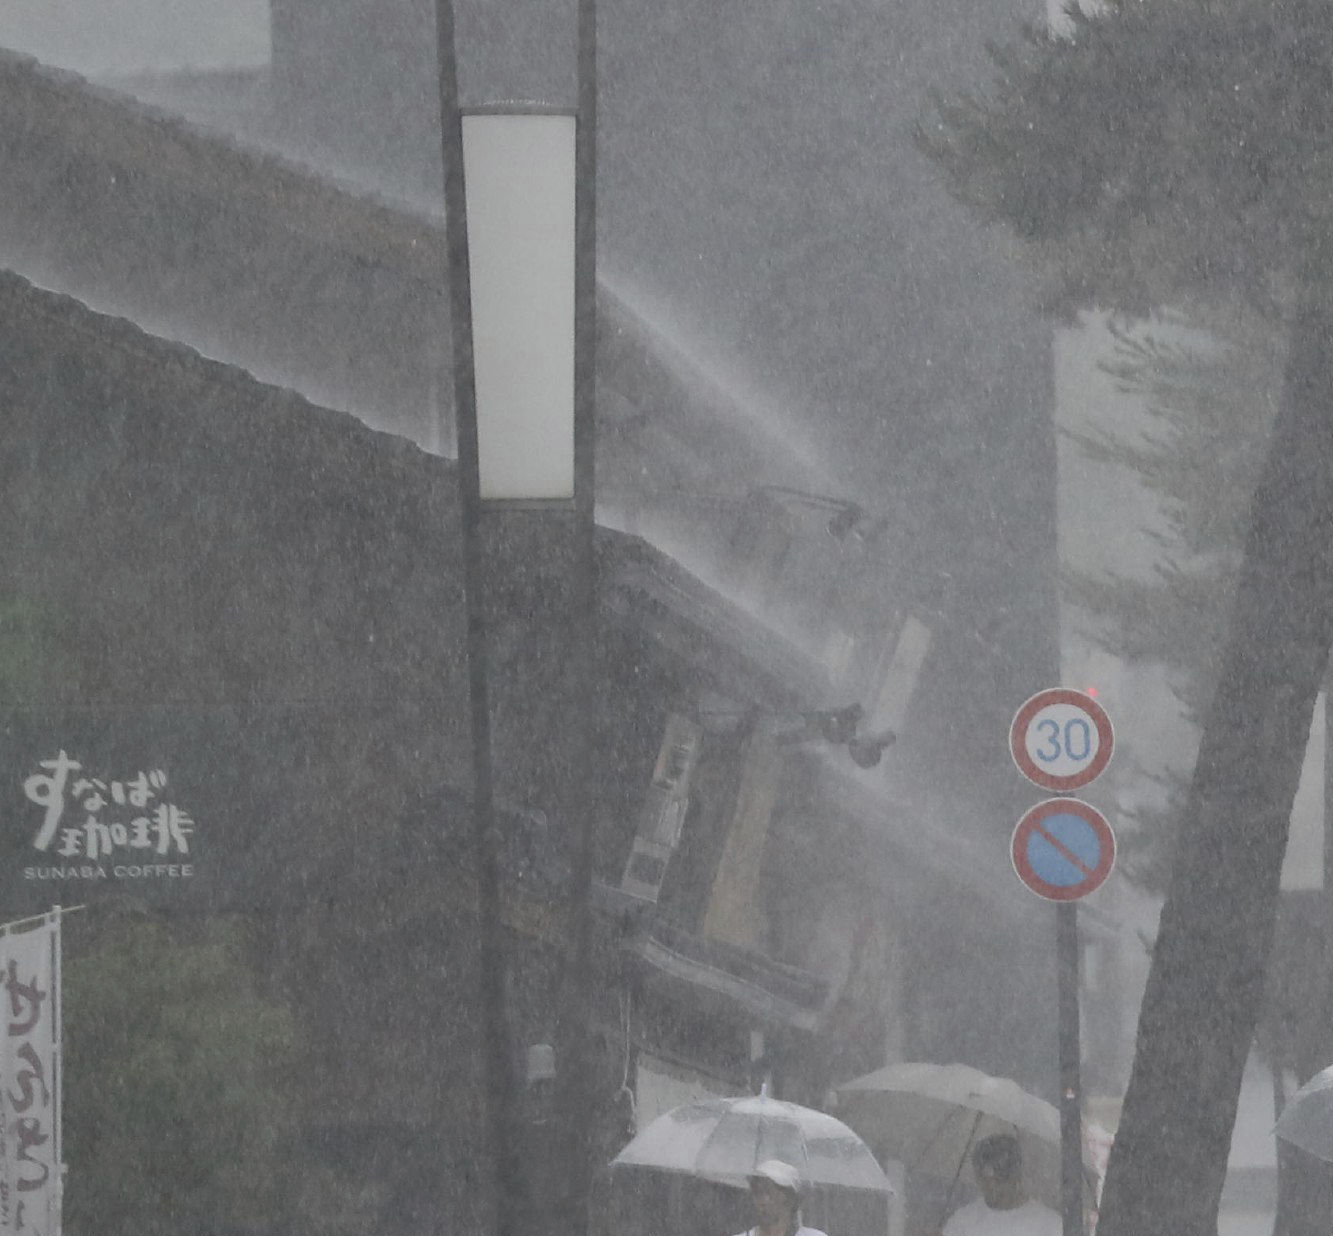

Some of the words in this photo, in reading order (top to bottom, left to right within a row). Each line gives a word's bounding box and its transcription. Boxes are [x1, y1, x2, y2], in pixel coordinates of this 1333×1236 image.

[1037, 719, 1090, 761] 30
[24, 749, 167, 850] すなば
[57, 803, 195, 860] 珈琲
[23, 866, 107, 881] SUNABA
[114, 864, 194, 879] COFFEE
